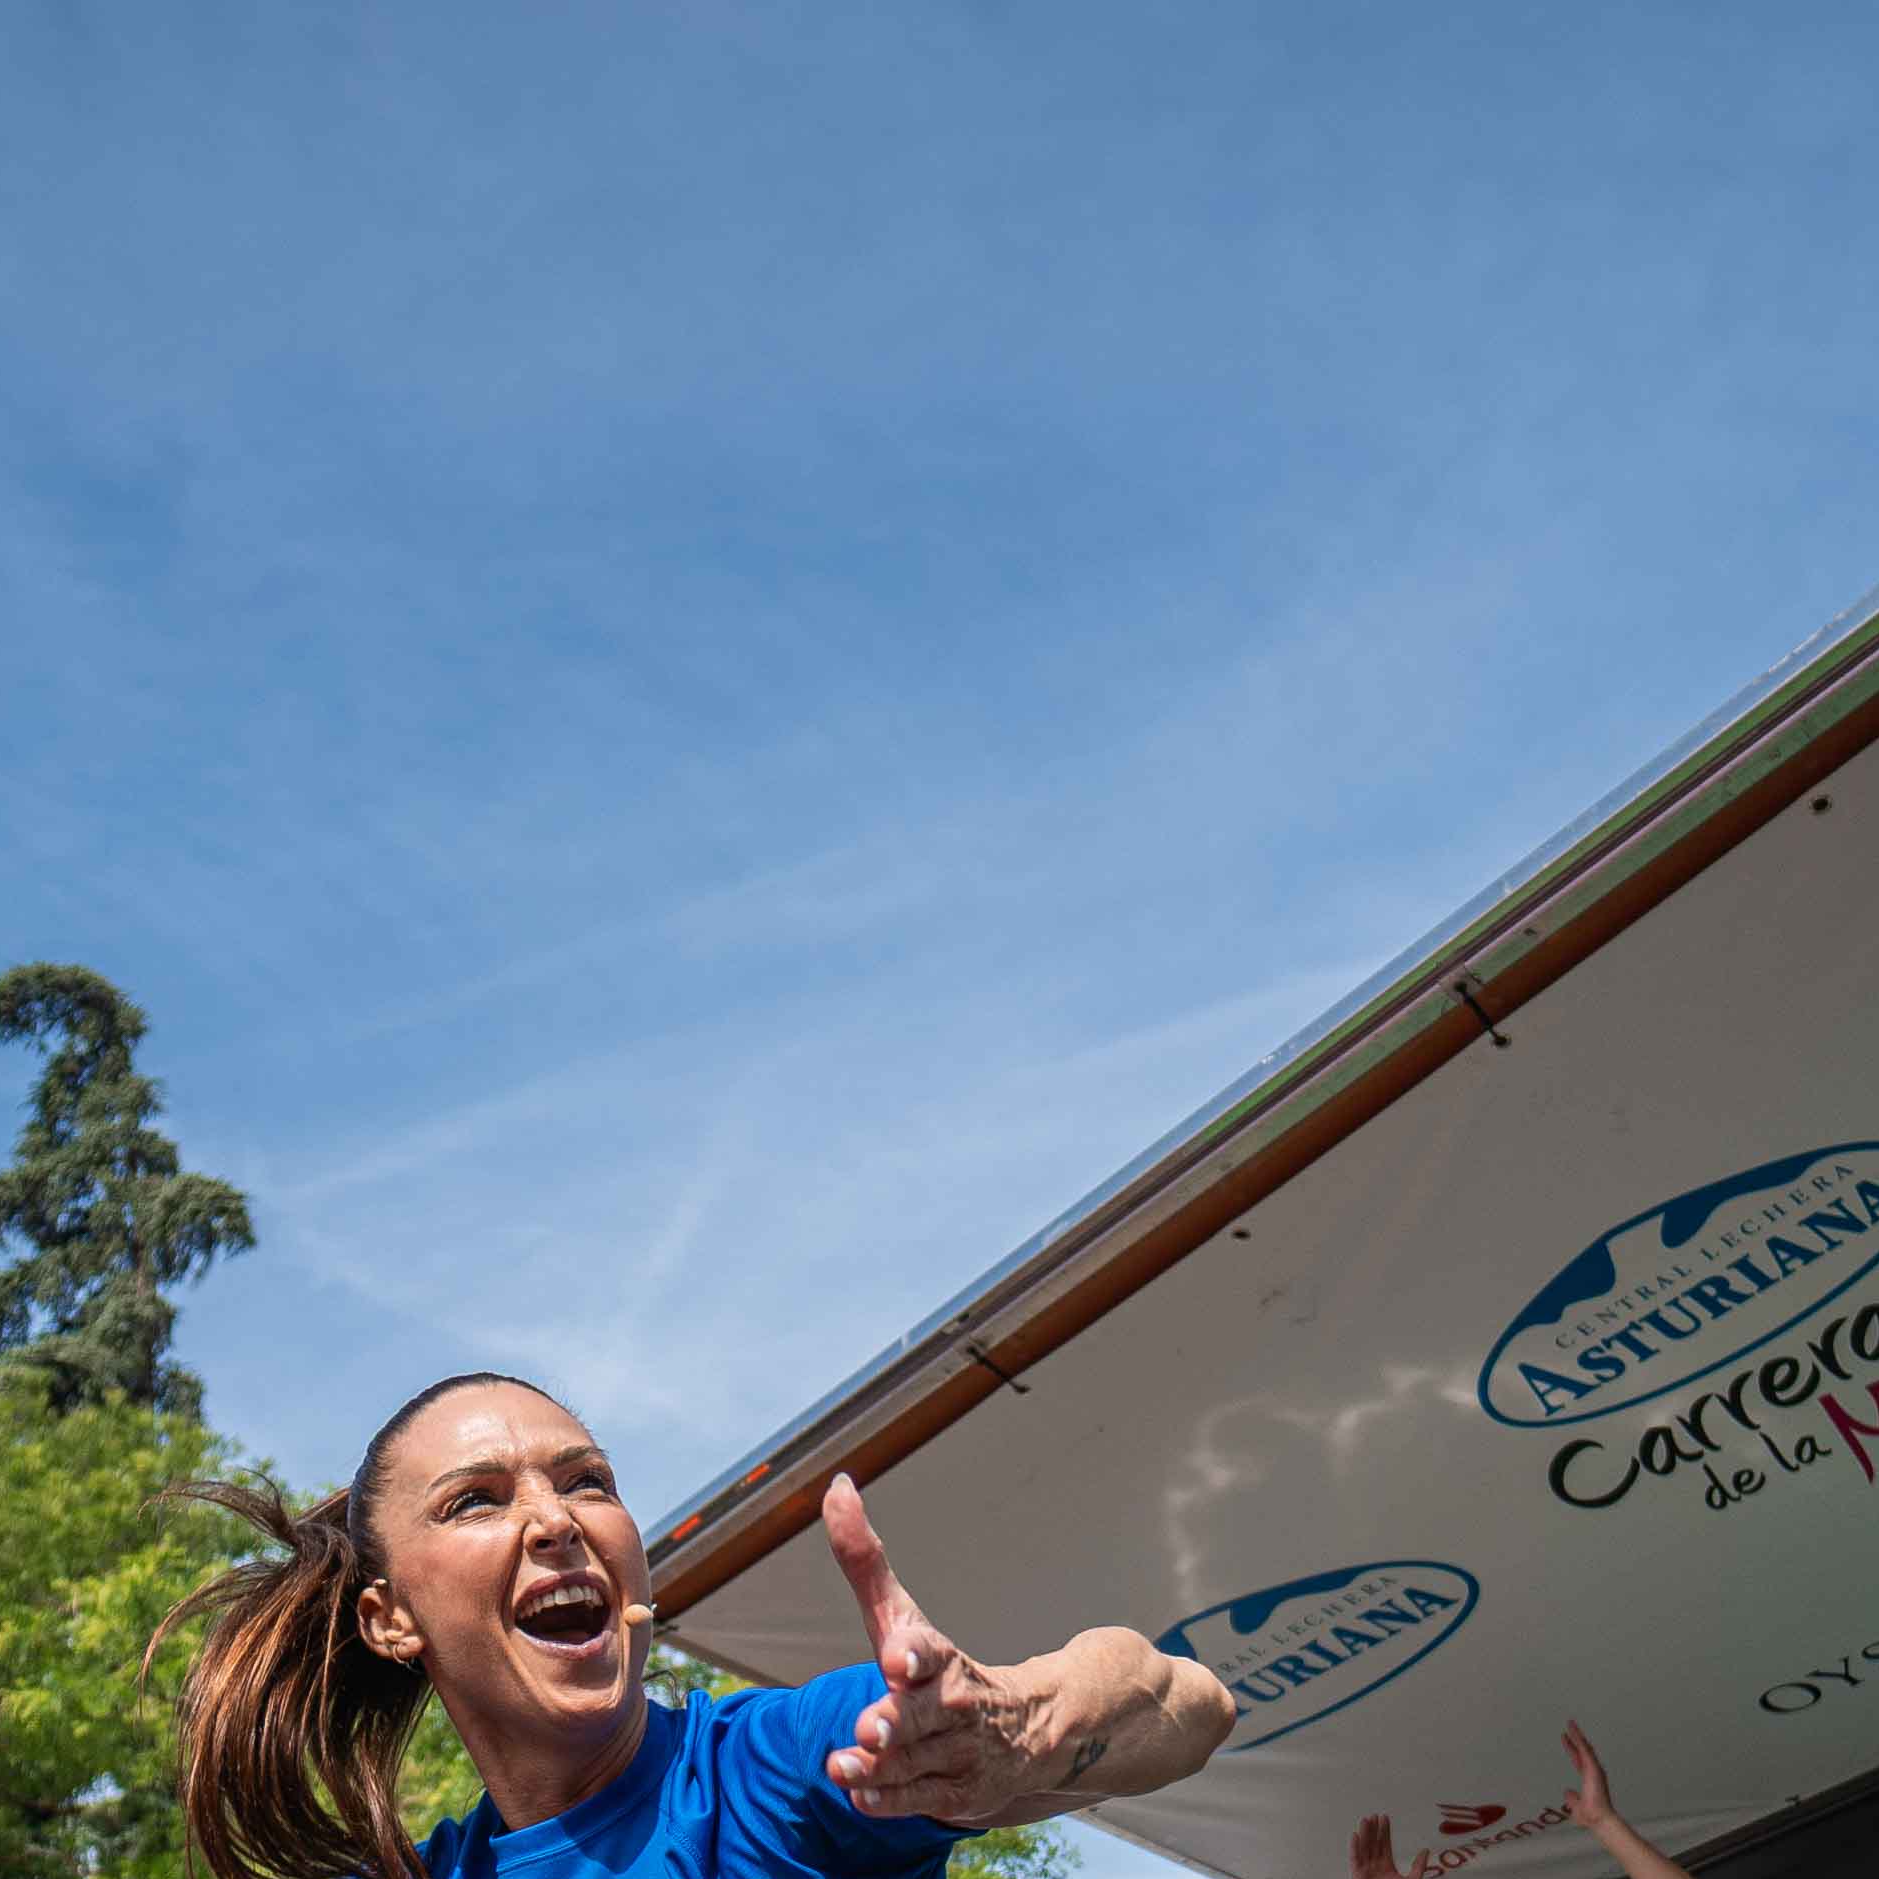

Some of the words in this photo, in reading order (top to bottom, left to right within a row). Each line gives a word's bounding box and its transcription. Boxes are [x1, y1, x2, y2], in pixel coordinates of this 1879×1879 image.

[1555, 1265, 1692, 1350] CENTRAL
[1700, 1164, 1856, 1262] LECHERA
[1702, 1463, 1766, 1511] de
[1759, 1430, 1833, 1472] la
[1271, 1575, 1399, 1646] LECHERA
